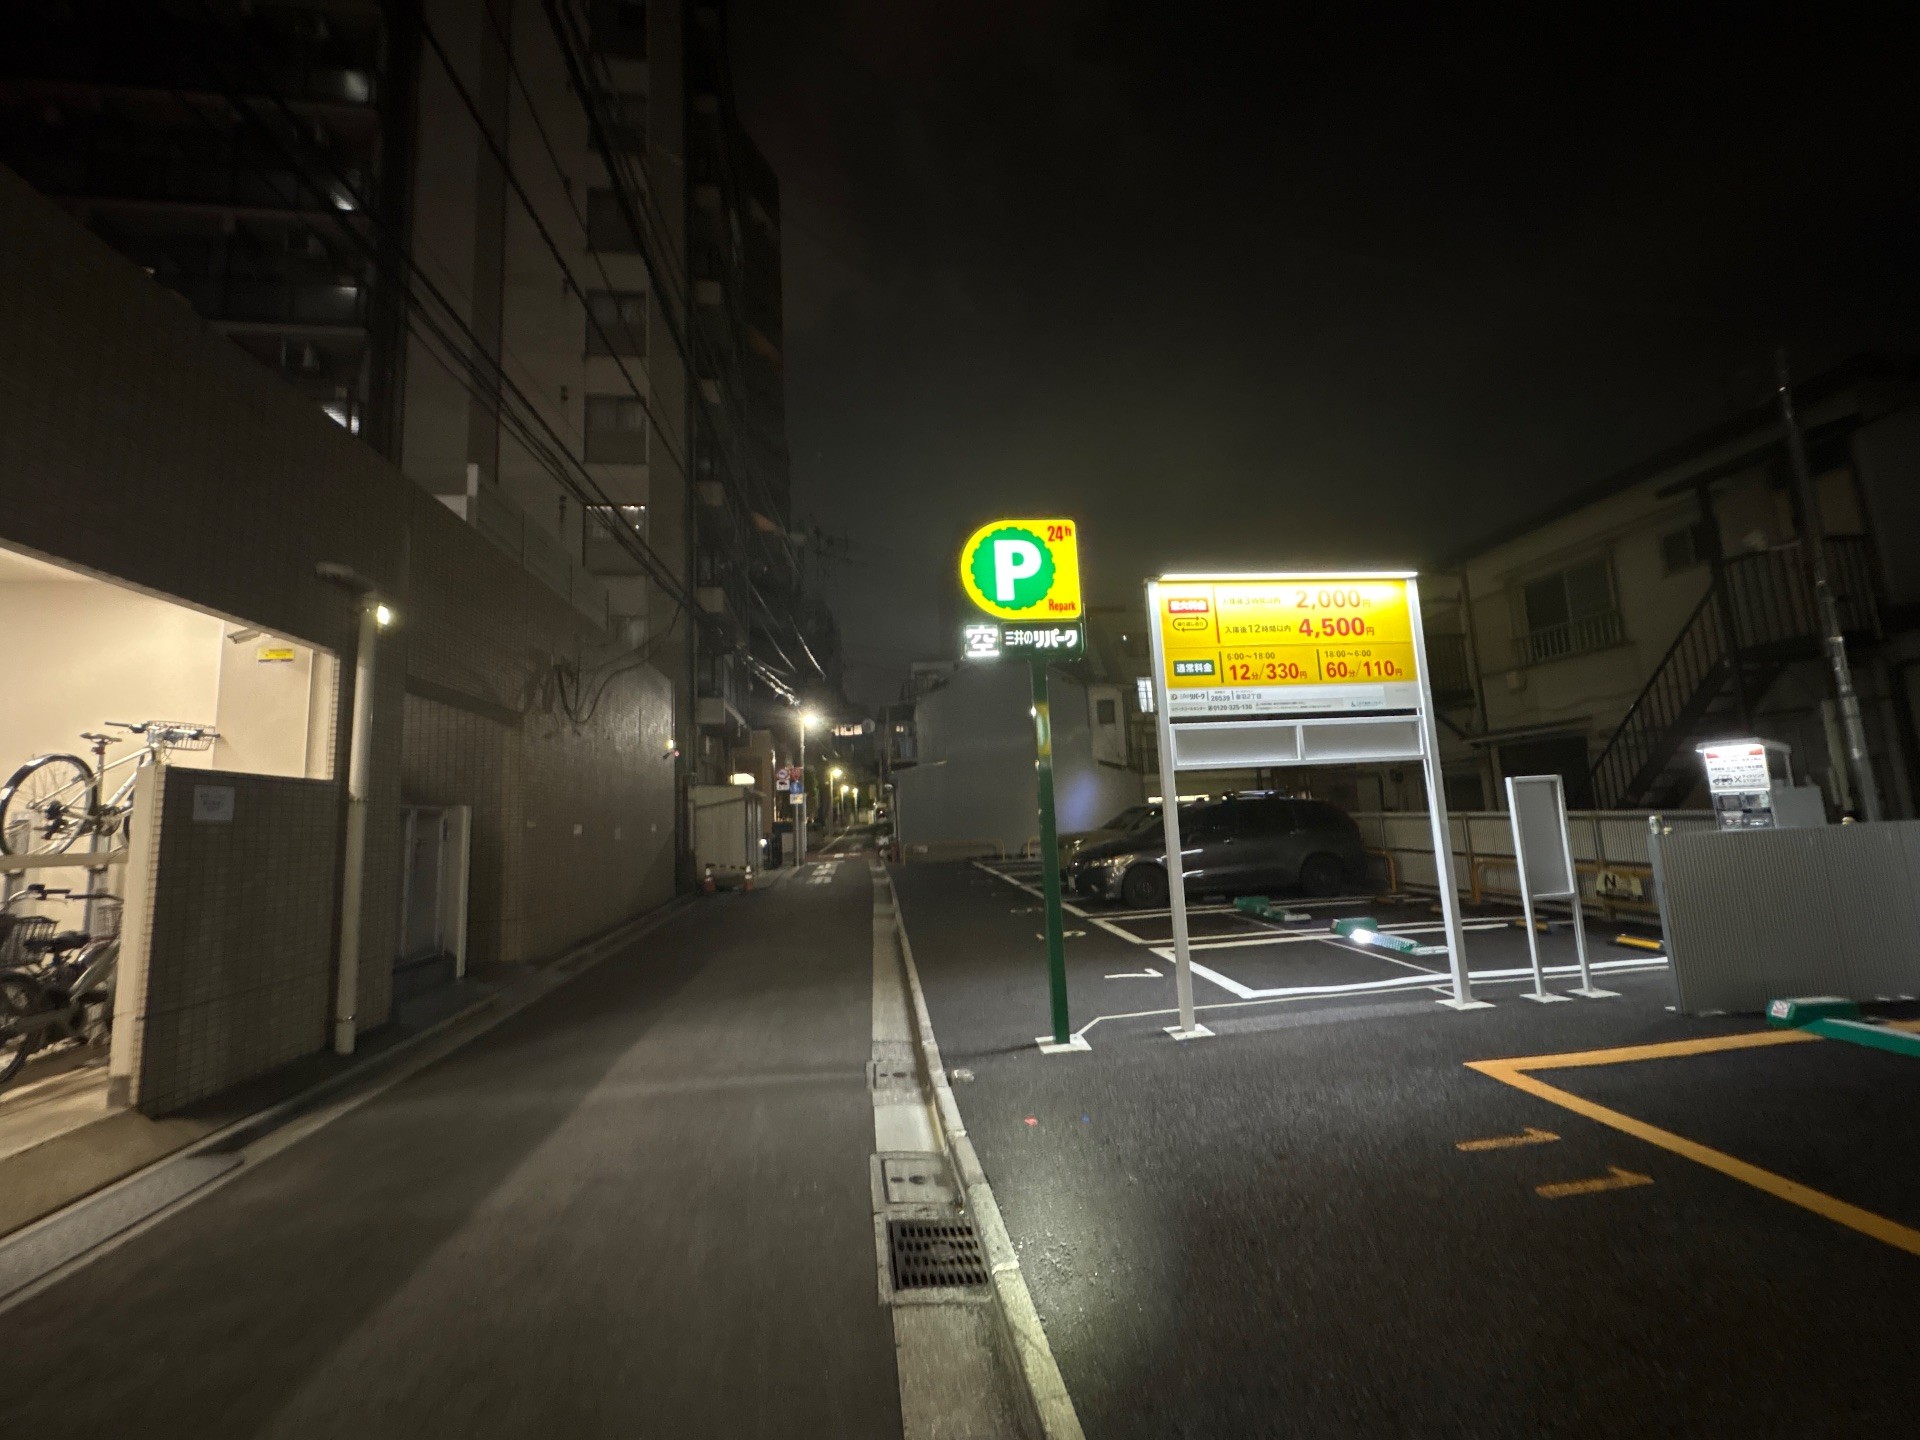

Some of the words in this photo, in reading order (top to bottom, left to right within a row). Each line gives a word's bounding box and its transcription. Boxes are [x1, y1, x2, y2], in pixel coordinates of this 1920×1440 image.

[994, 540, 1042, 602] P
[1049, 599, 1076, 613] Repark
[1225, 623, 1291, 634] 入庫後12時間以内
[1299, 617, 1375, 638] 4,500円
[966, 625, 1000, 658] 空
[1005, 628, 1078, 648] 三井のリパーク
[1176, 662, 1213, 673] 通常料金
